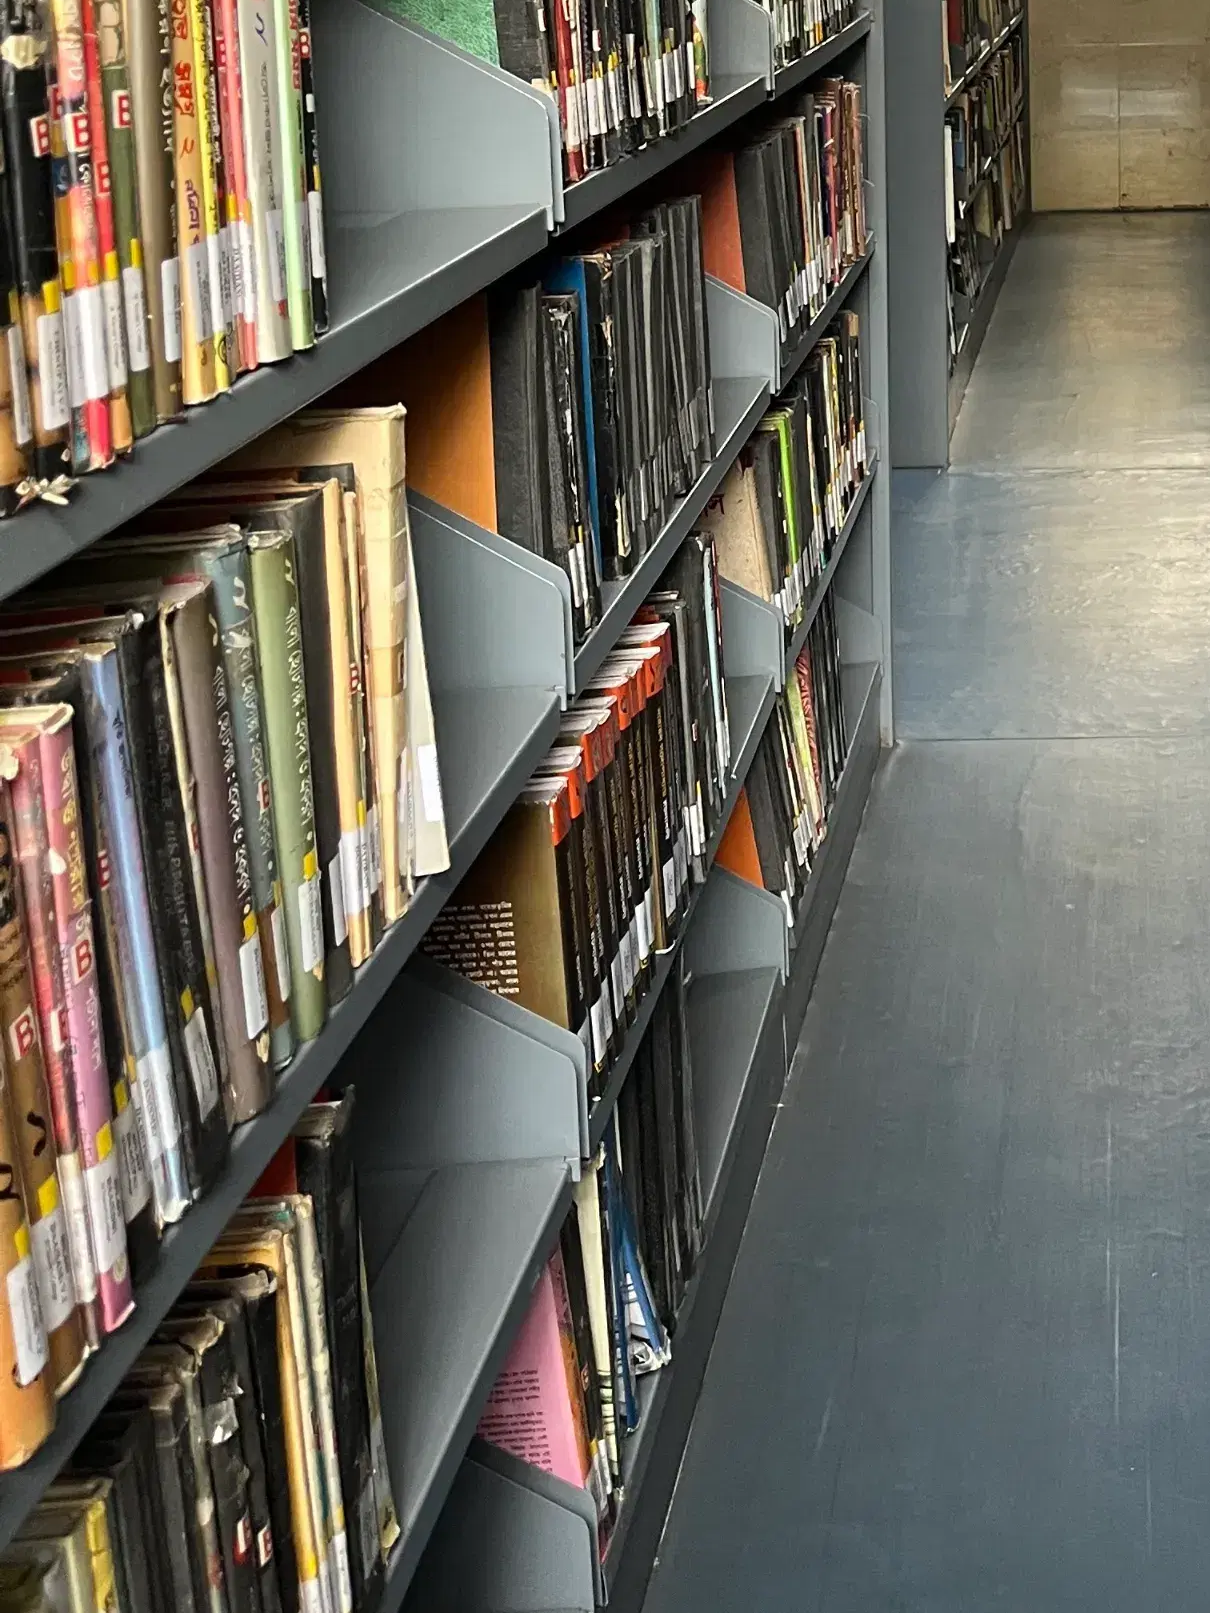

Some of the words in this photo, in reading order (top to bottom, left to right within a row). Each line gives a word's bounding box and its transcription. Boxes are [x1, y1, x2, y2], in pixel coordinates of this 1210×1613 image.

[299, 32, 310, 60] B
[119, 94, 130, 127] B
[39, 119, 50, 151] B
[74, 114, 91, 147] B
[98, 161, 111, 193] B
[350, 667, 360, 694] B
[76, 940, 93, 979] B
[14, 1015, 32, 1050] B
